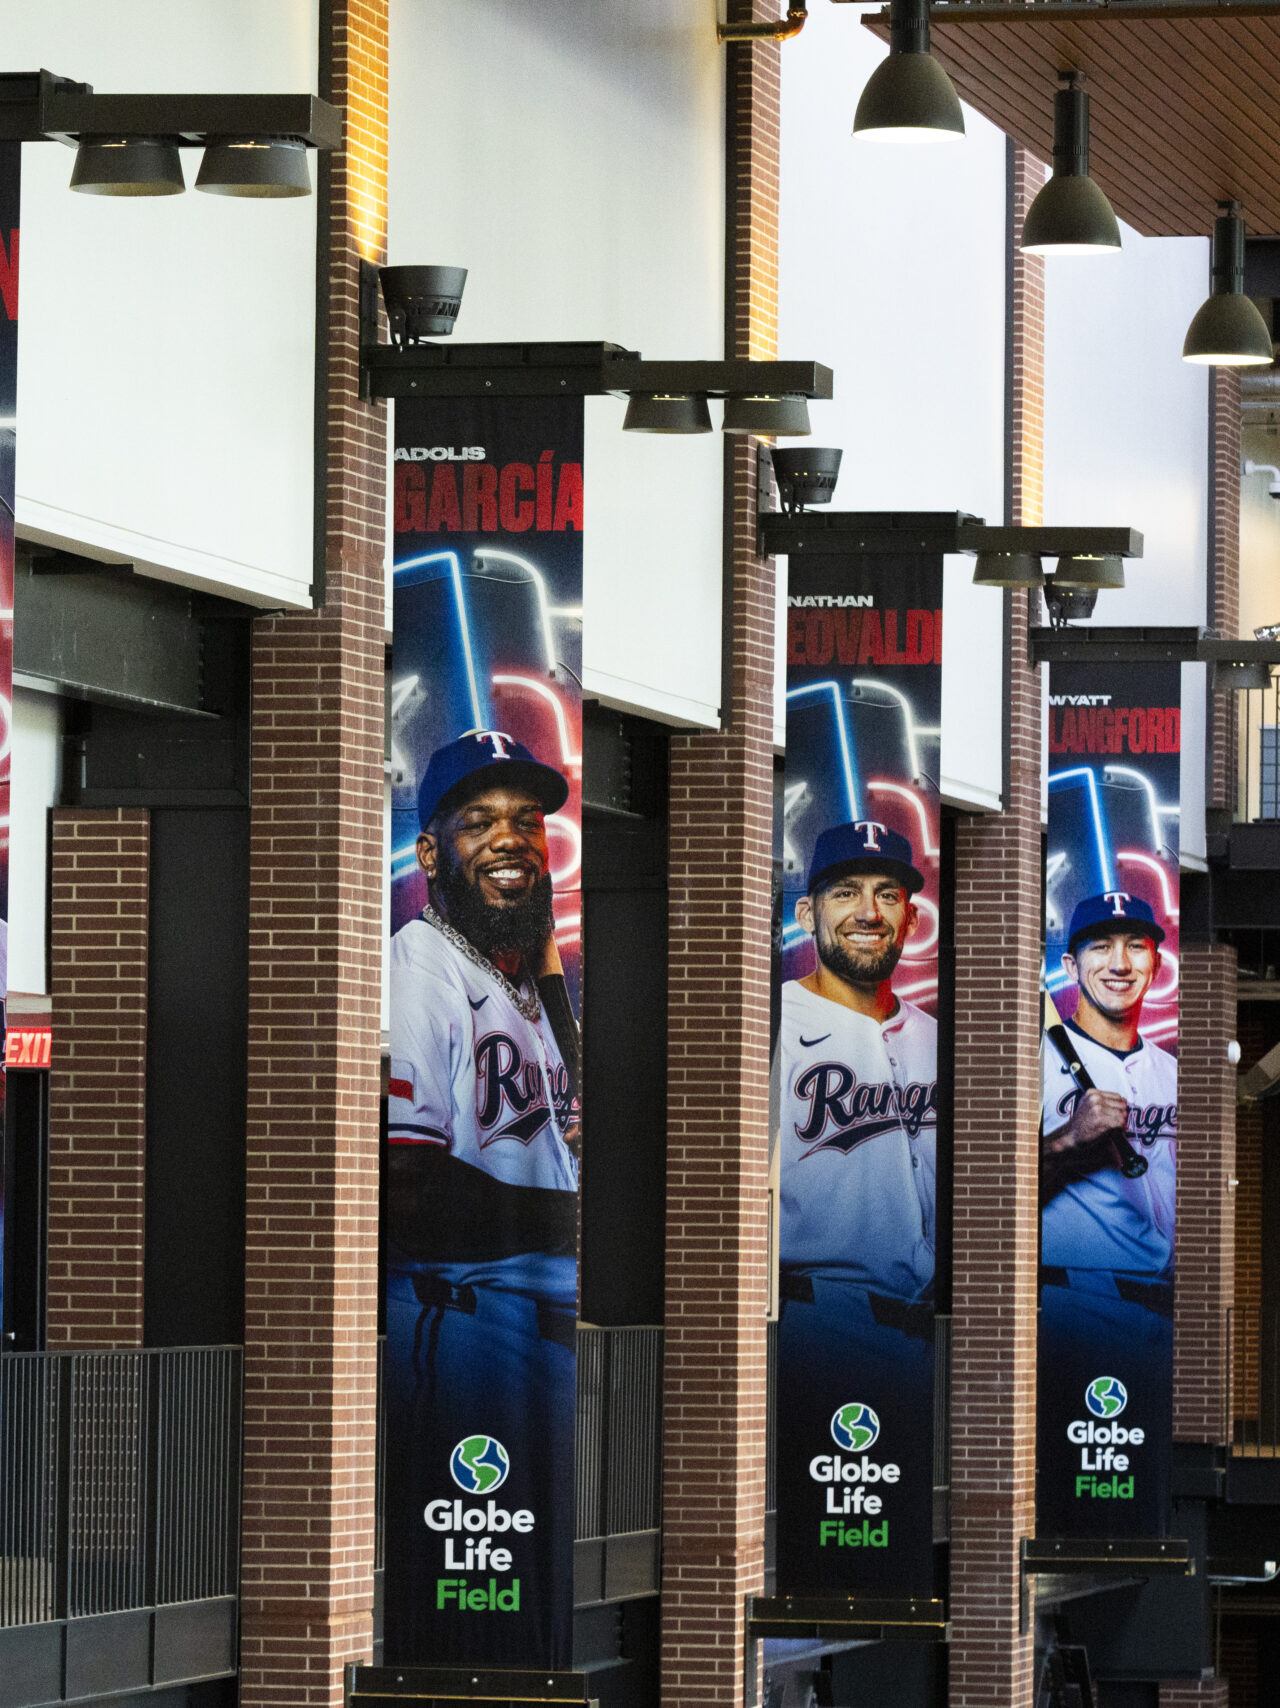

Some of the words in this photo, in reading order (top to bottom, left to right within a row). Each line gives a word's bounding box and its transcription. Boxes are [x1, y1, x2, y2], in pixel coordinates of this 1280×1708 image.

[394, 447, 486, 461] ADOLIS
[394, 450, 584, 532] GARCÍA
[788, 595, 873, 607] NATHAN
[787, 609, 942, 665] EOVALDI
[1048, 695, 1112, 706] WYATT
[1049, 707, 1181, 753] LANGFORD
[854, 821, 888, 852] T
[1104, 892, 1131, 918] T
[6, 1032, 52, 1064] EXIT
[1067, 1420, 1145, 1445] Globe
[809, 1455, 901, 1483] Globe
[1081, 1447, 1129, 1471] Life
[826, 1486, 882, 1515] Life
[1075, 1475, 1134, 1498] Field
[424, 1499, 535, 1533] Globe
[820, 1520, 888, 1547] Field
[445, 1537, 513, 1571] Life
[436, 1578, 520, 1611] Field
